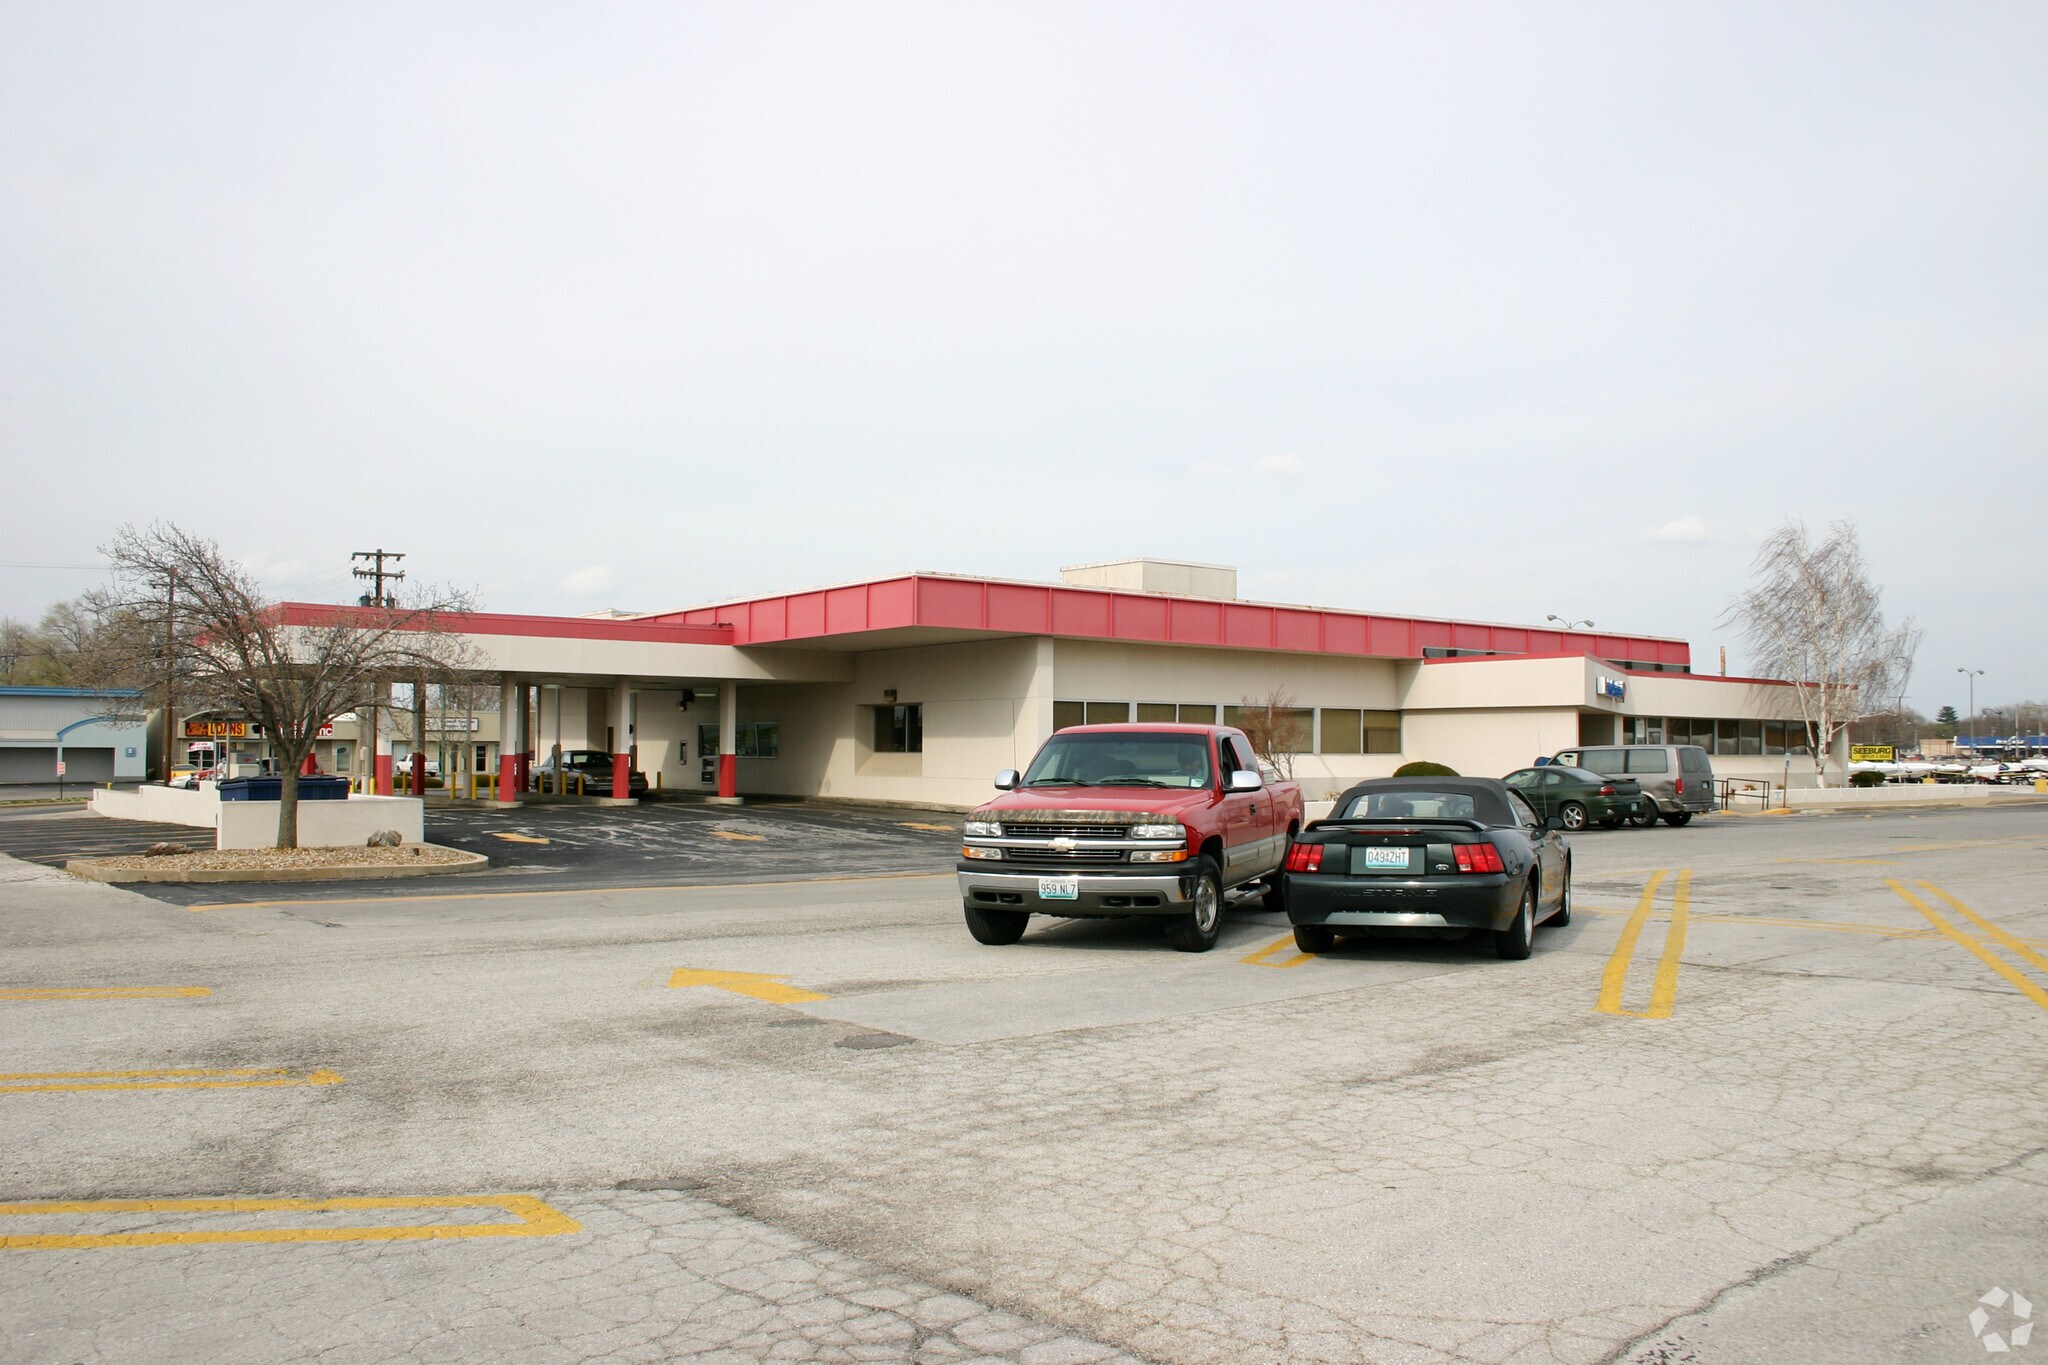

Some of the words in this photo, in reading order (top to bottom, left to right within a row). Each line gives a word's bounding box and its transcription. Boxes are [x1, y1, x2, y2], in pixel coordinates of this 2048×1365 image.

[210, 722, 243, 735] LOANS
[1853, 747, 1892, 755] SEEBURG
[1367, 851, 1386, 863] 049
[1040, 883, 1057, 895] 959
[1059, 884, 1076, 895] NL7
